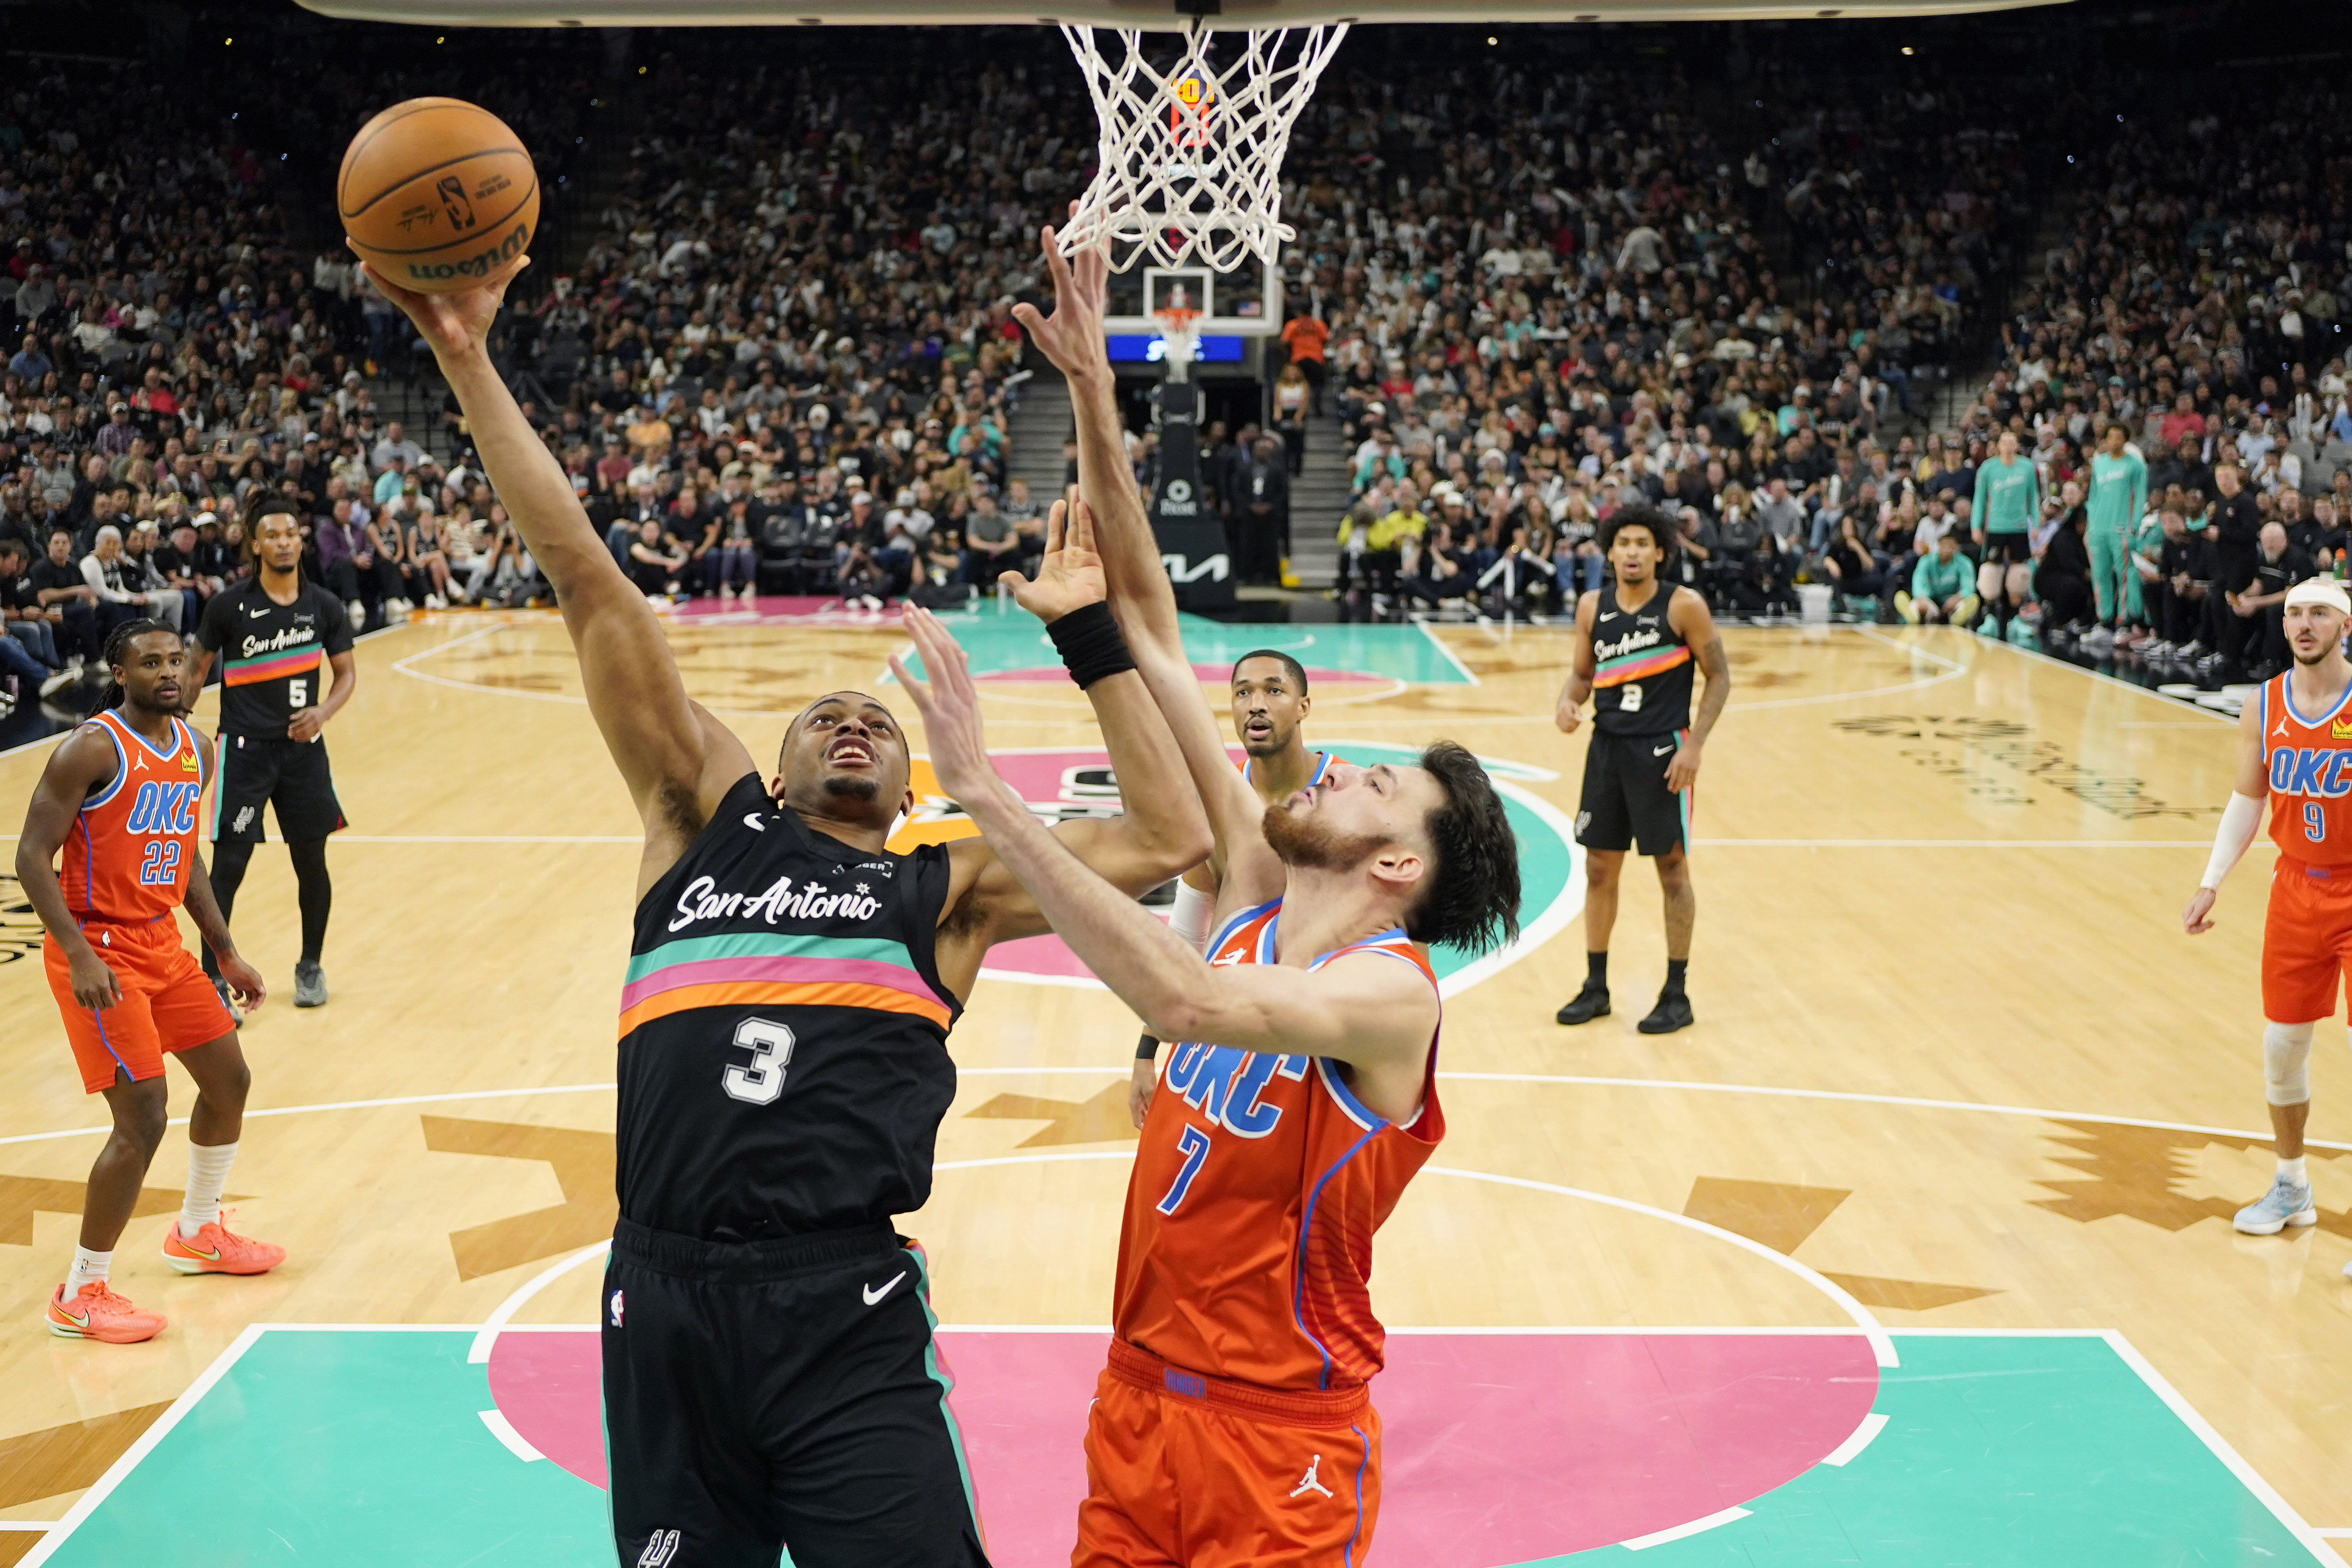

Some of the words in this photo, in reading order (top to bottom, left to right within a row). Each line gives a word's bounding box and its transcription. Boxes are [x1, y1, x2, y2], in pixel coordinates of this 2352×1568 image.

[408, 223, 529, 280] Wilson
[242, 635, 270, 658] San
[270, 625, 315, 651] Antonio
[1594, 639, 1616, 662] San
[1616, 628, 1661, 656] Antonio
[289, 678, 308, 708] 5
[1619, 683, 1643, 713] 2
[2269, 746, 2352, 798] OKC
[126, 780, 201, 835] OKC
[2303, 801, 2325, 843] 9
[140, 840, 181, 885] 22
[668, 875, 744, 932] San
[742, 876, 882, 925] Antonio
[721, 1016, 796, 1105] 3
[1156, 1123, 1211, 1216] 7
